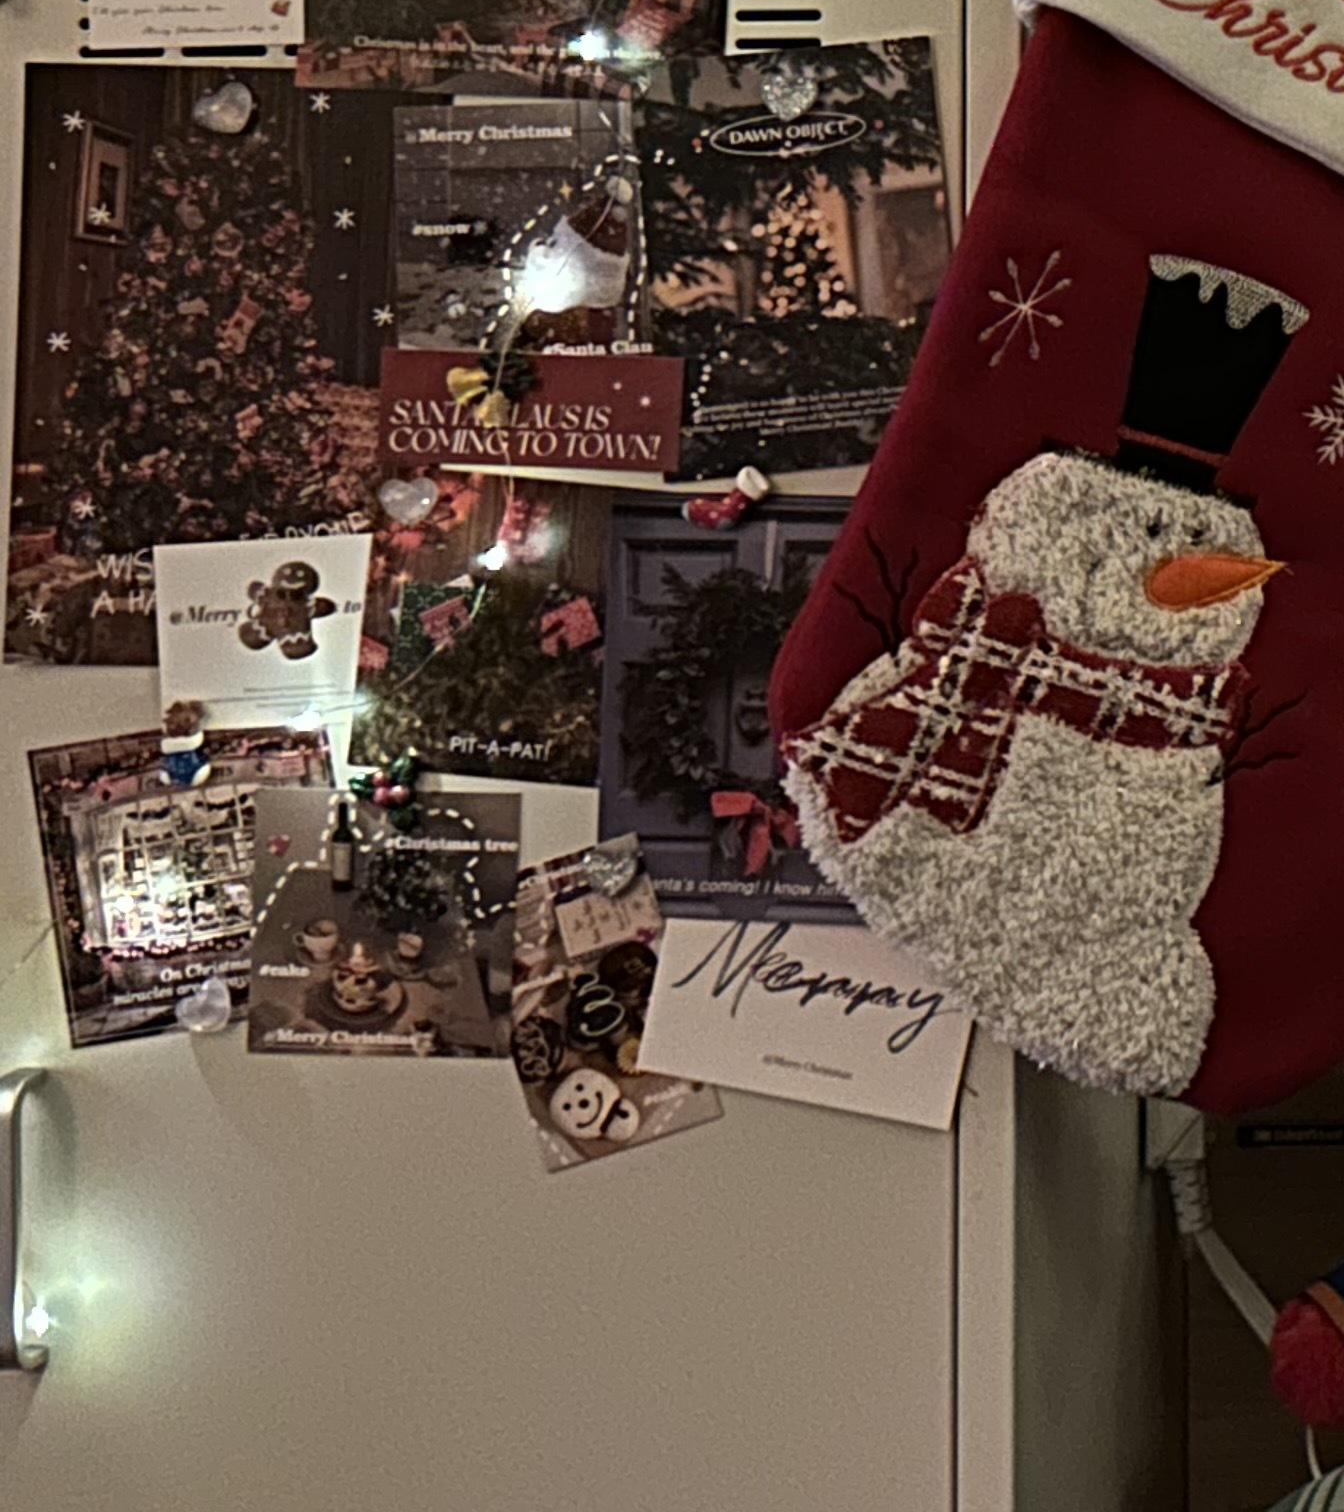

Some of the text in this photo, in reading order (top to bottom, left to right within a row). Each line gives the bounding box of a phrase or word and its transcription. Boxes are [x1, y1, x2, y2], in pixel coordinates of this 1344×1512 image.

[418, 124, 573, 145] Merry Christmas
[728, 120, 848, 145] DAWN OBJECT
[511, 402, 580, 430] LAUS
[585, 405, 613, 431] IS
[389, 427, 662, 461] COMING TO TOWN!
[448, 734, 554, 762] PIT-A-PAT!
[485, 838, 519, 852] tree
[699, 878, 760, 896] coming!
[773, 880, 812, 896] know
[159, 967, 183, 983] On
[113, 986, 174, 1006] miracles
